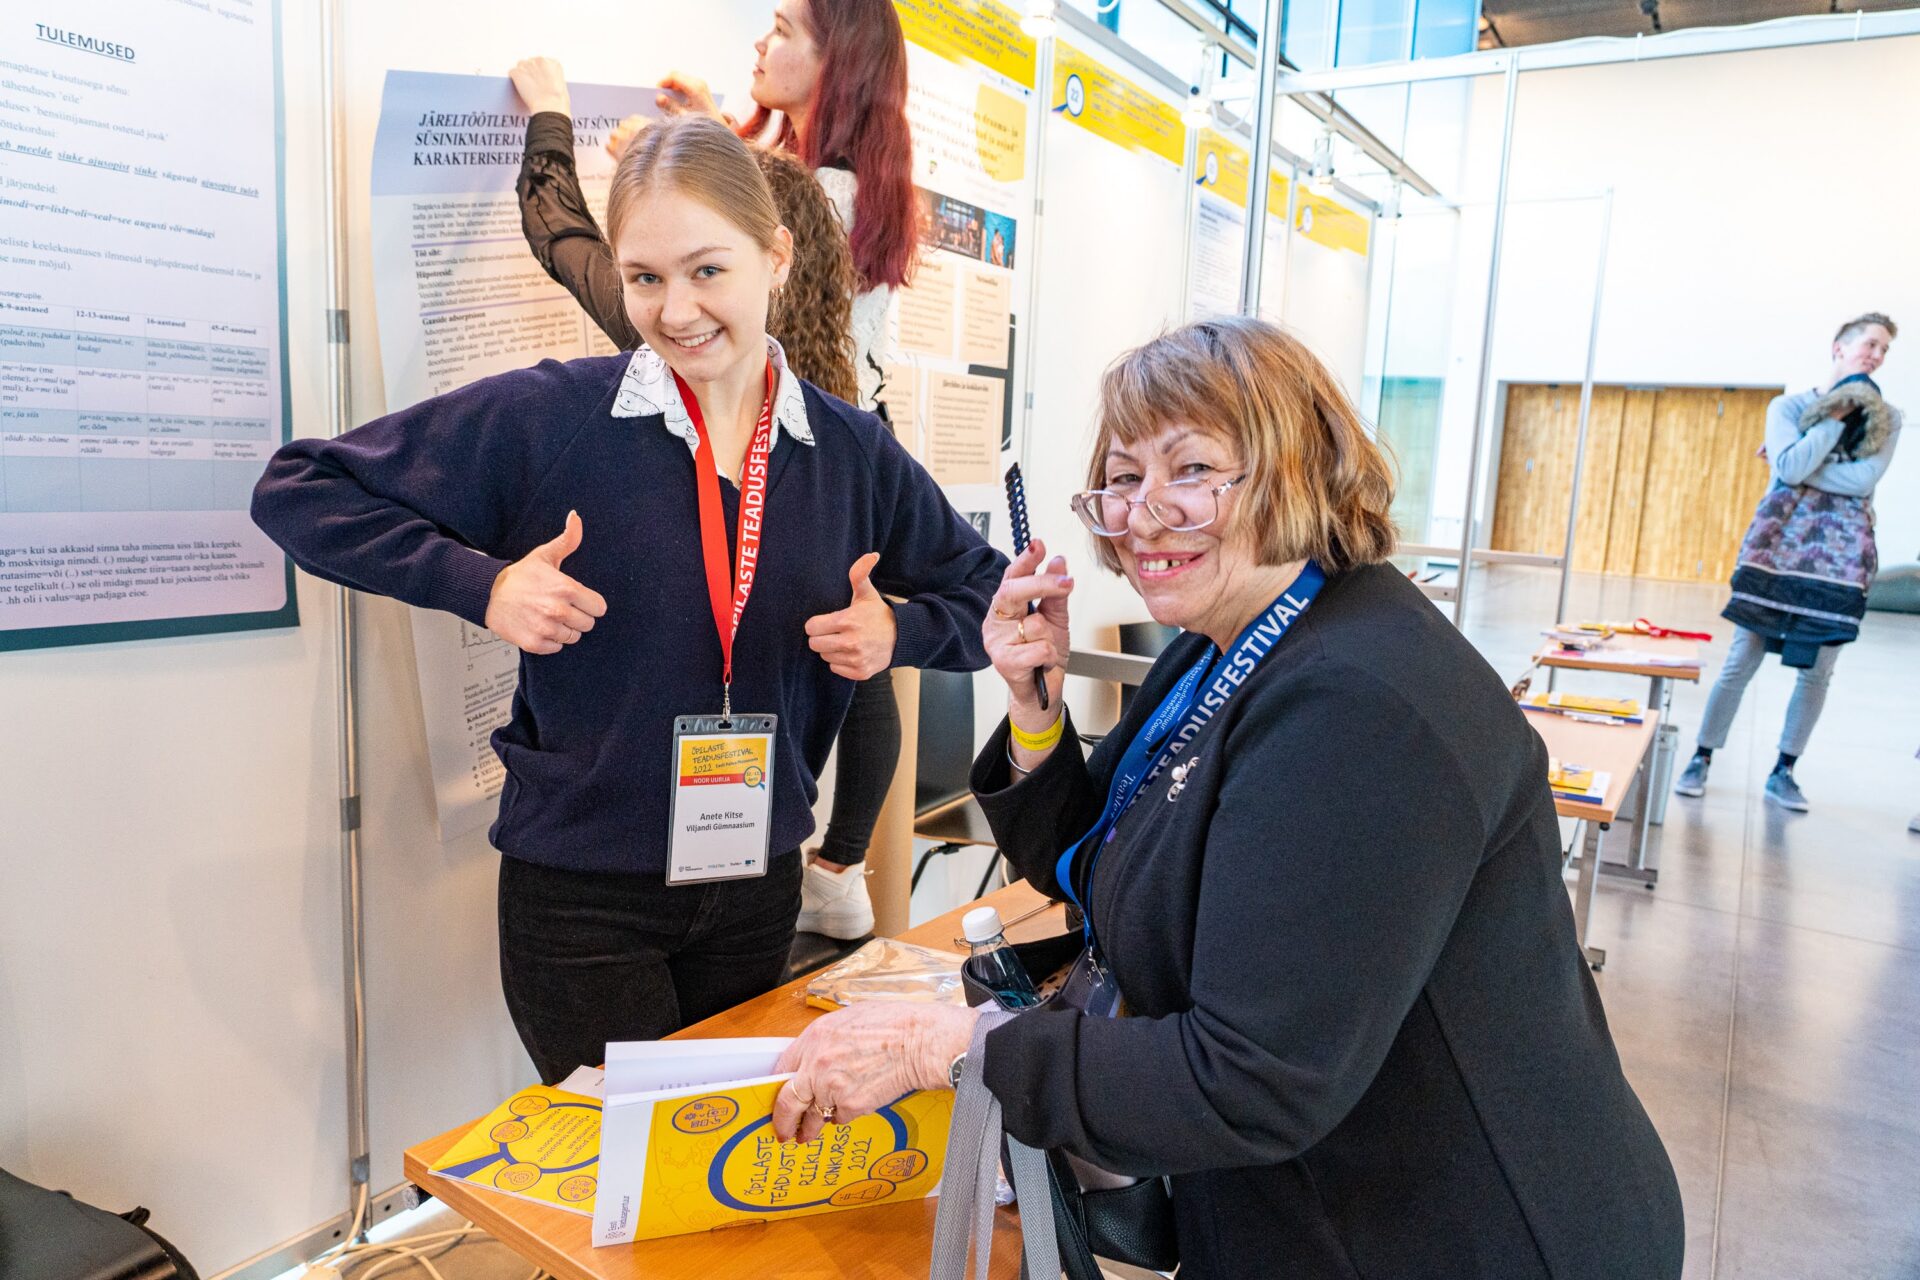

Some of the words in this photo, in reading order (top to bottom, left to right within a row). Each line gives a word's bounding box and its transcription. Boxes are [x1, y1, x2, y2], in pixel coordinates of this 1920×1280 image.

[36, 23, 136, 62] TULEMUSED
[415, 130, 524, 147] SÜSINIKMATERJA
[413, 152, 524, 166] KARAKTERISEER
[743, 398, 769, 542] TEADUSFESTIV
[30, 546, 45, 554] kui
[60, 545, 94, 553] akkasid
[97, 544, 120, 552] sinna
[121, 543, 140, 551] taha
[14, 582, 58, 593] tegelikult
[88, 579, 101, 588] oli
[103, 579, 133, 589] midagi
[23, 595, 36, 603] oli
[1161, 691, 1181, 719] Research
[1144, 718, 1164, 742] Council
[693, 747, 754, 764] TEADUSFESTIVAL
[700, 812, 723, 820] Anete
[724, 811, 744, 819] Kitse
[686, 823, 712, 833] Viljandi
[712, 822, 755, 831] Gümnaasium
[822, 1125, 852, 1187] KONKURSS
[744, 1136, 775, 1196] ÕPILASTE
